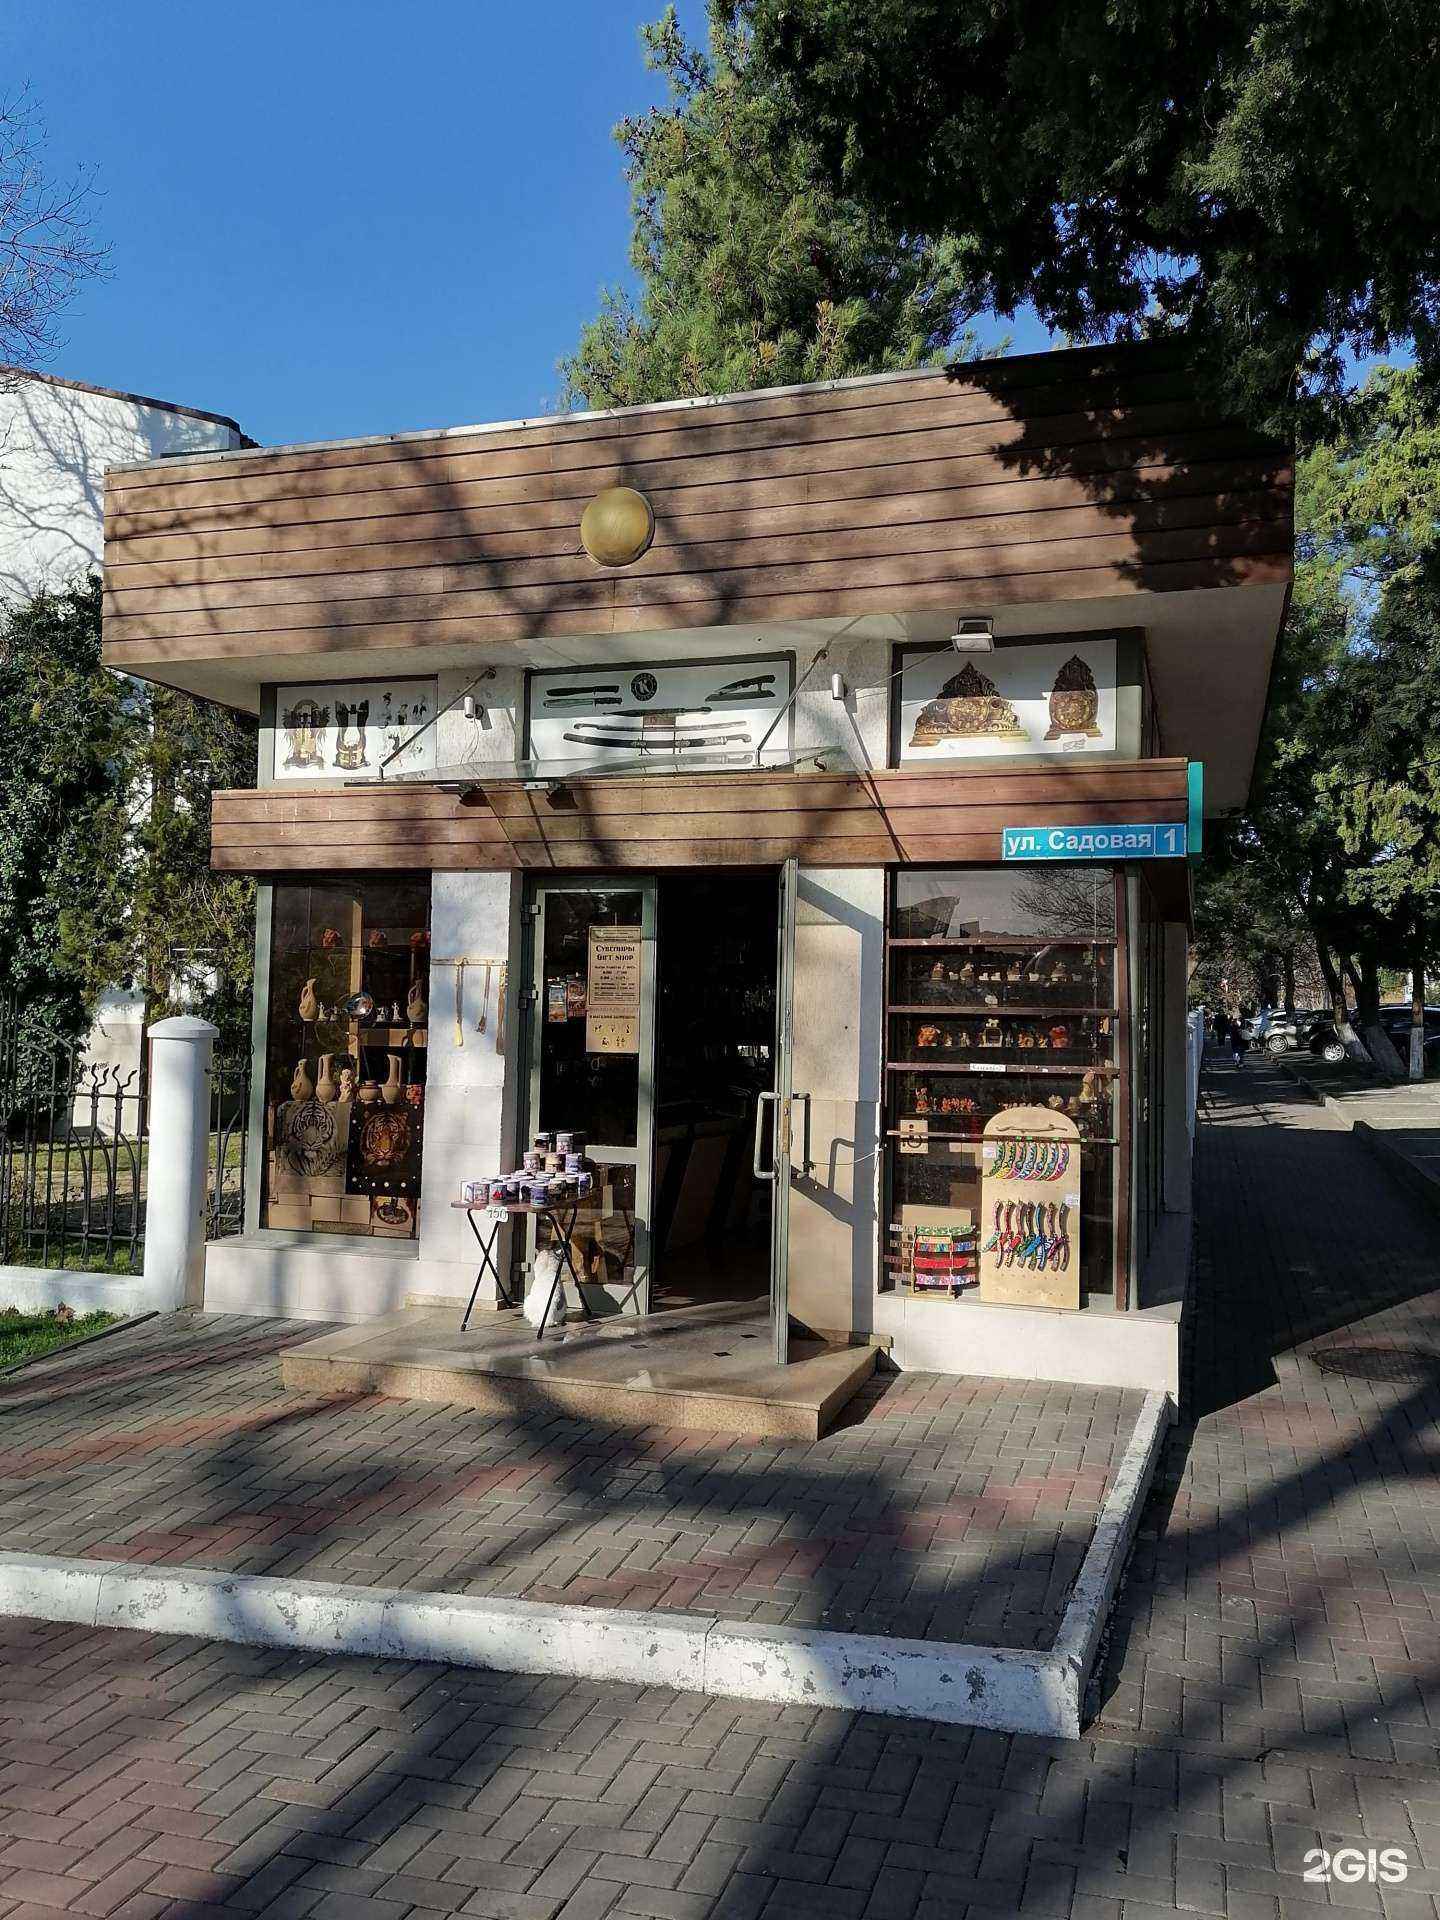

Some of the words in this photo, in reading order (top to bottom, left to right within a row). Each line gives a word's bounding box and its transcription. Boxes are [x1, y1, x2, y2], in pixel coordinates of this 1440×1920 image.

[1007, 835, 1041, 856] ул.
[1048, 830, 1152, 852] Садовая
[1164, 828, 1177, 852] 1
